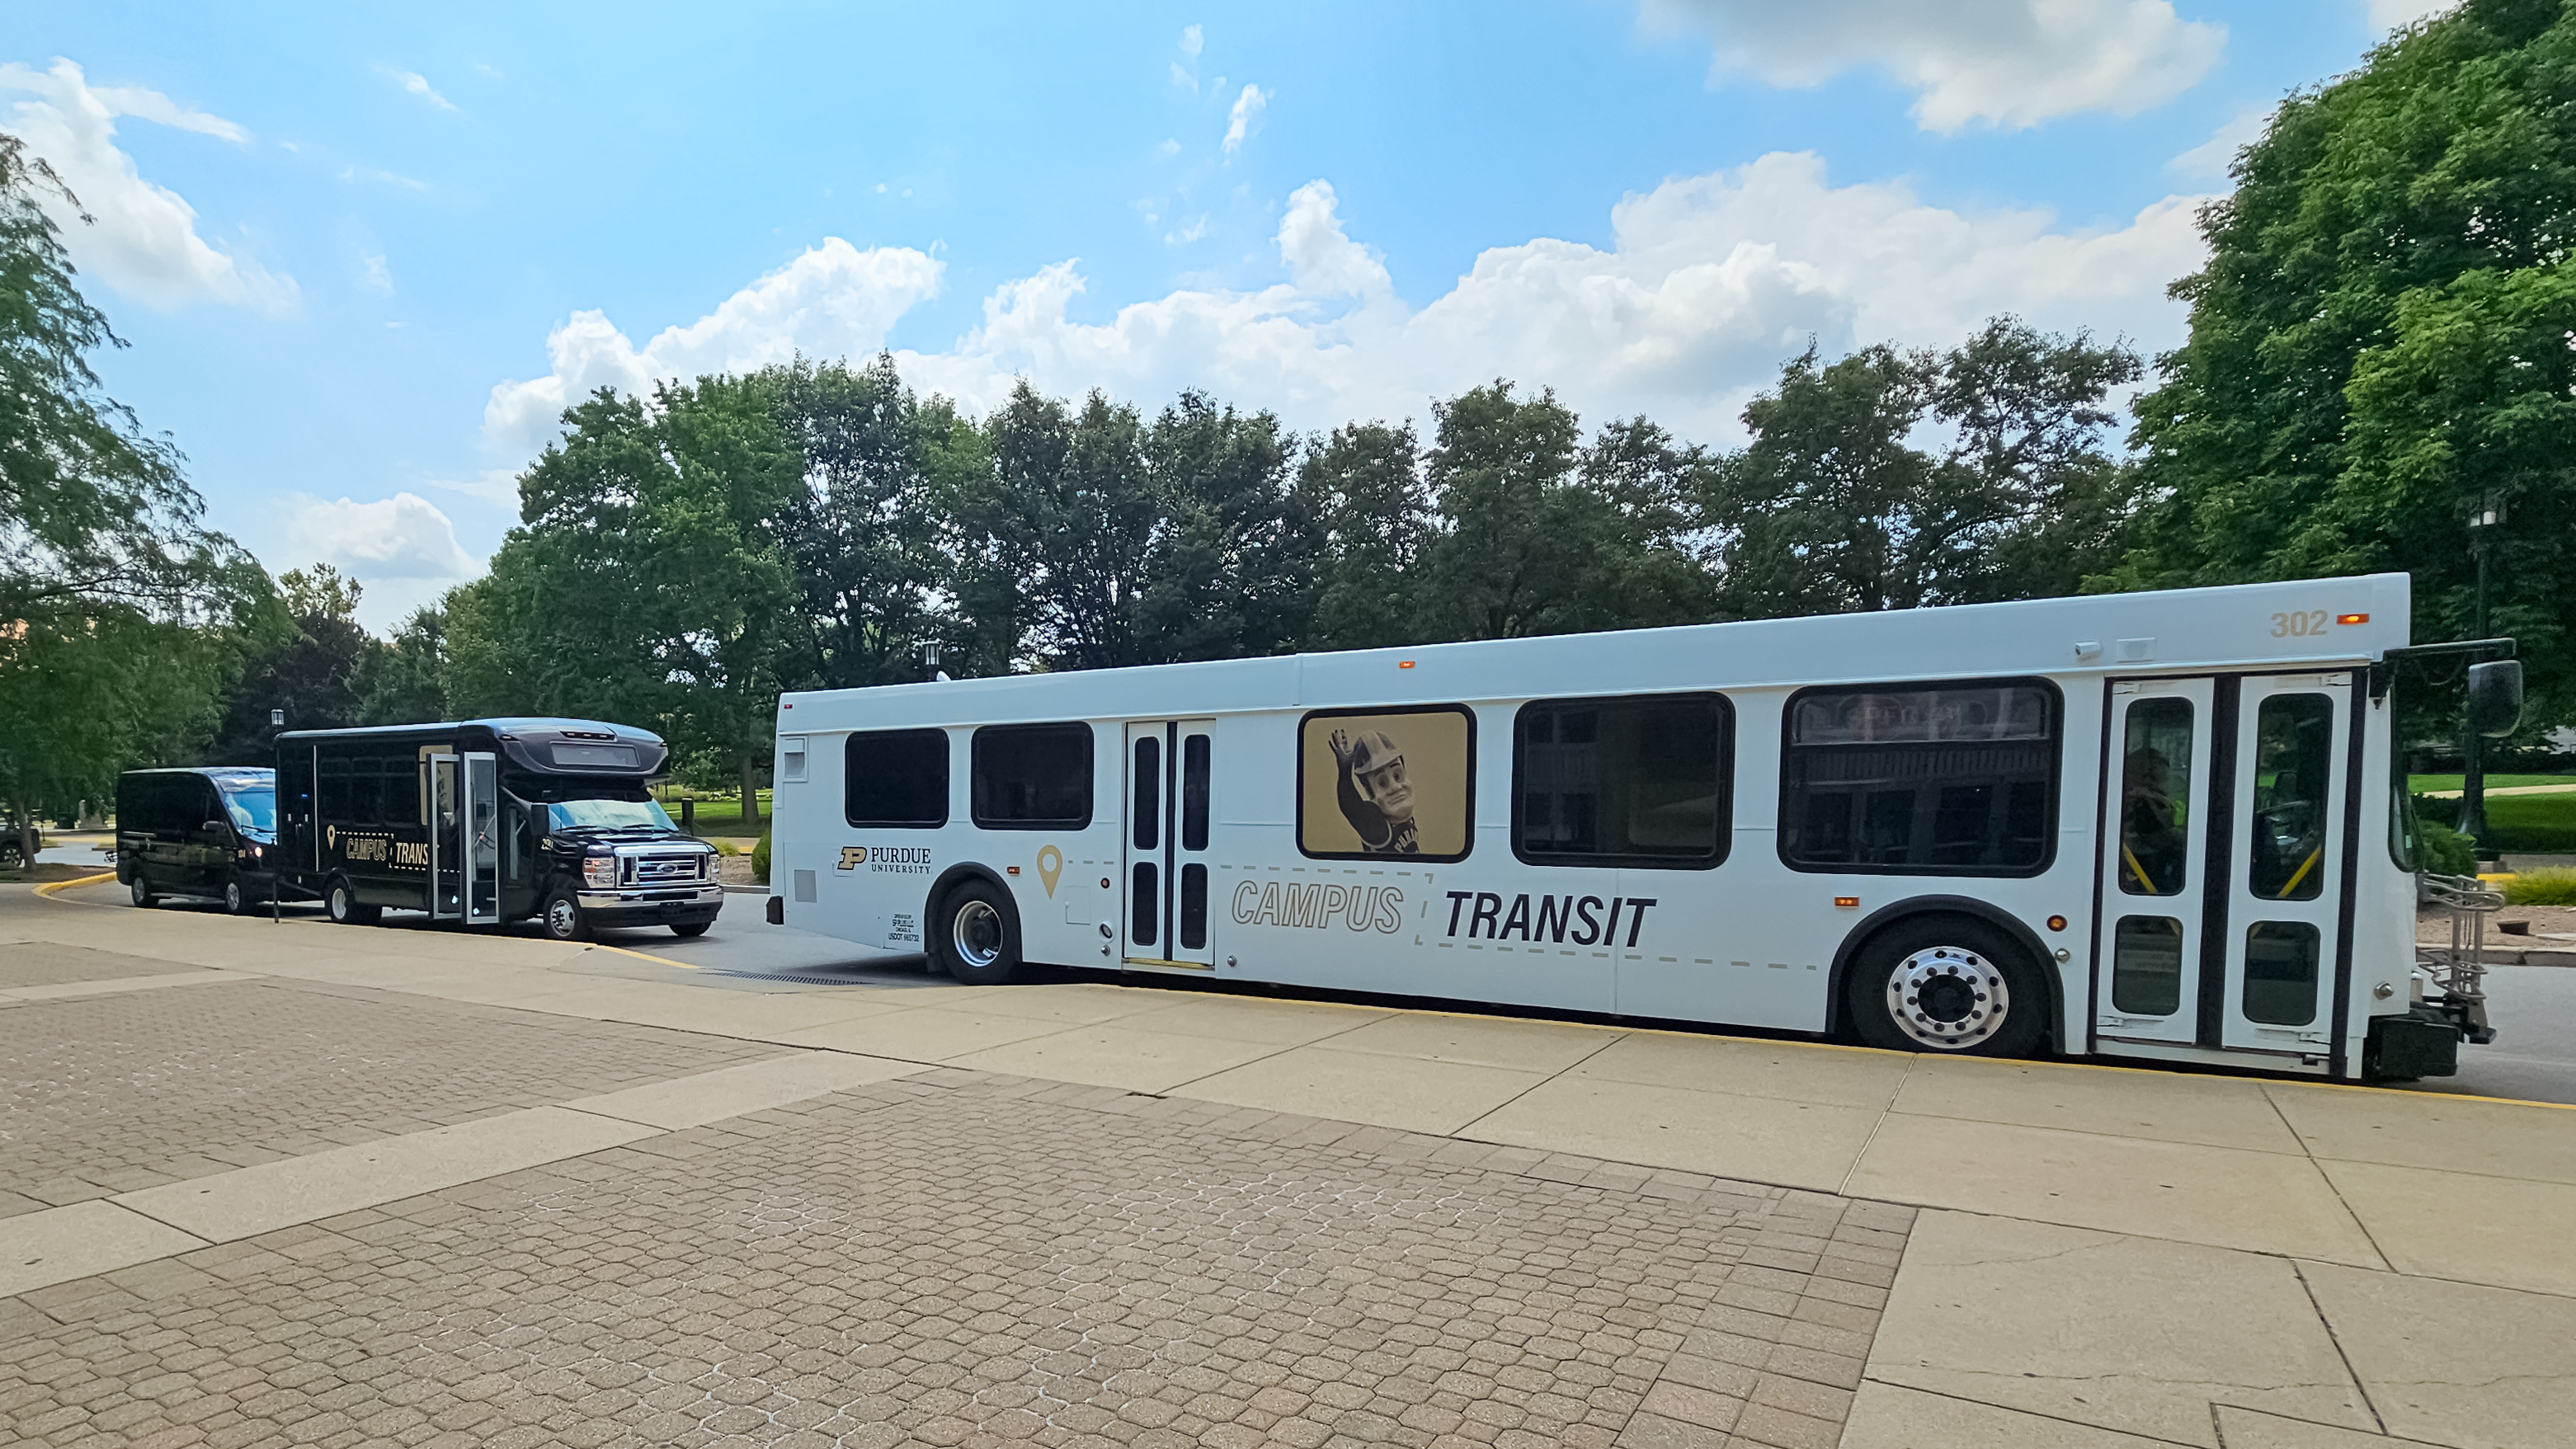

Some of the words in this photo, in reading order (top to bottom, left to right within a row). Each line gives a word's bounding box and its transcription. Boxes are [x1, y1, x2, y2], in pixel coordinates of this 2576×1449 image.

[2270, 609, 2329, 638] 302
[346, 838, 387, 862] CAMPUS
[396, 842, 440, 865] TRANS
[837, 846, 868, 871] P
[870, 847, 931, 863] PURDUE
[871, 864, 931, 874] UNIVERSITY
[1231, 880, 1404, 934] CAMPUS
[1445, 890, 1658, 948] TRANSIT
